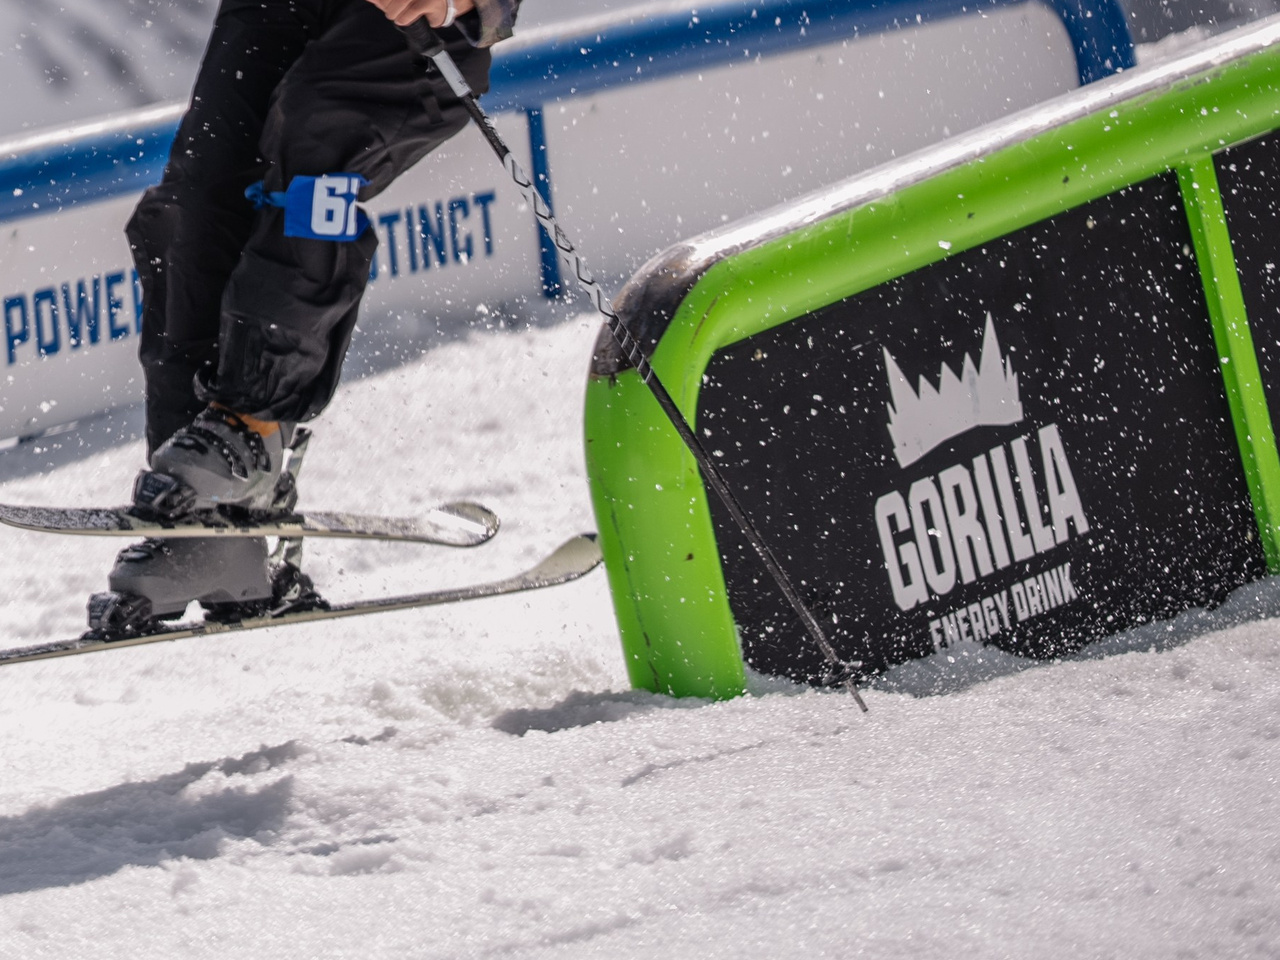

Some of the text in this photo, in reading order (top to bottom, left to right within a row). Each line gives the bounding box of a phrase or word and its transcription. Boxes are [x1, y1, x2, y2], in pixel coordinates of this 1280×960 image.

[368, 189, 496, 282] TINCT
[875, 423, 1090, 611] GORILLA
[929, 562, 1078, 653] ENERGY DRINK
